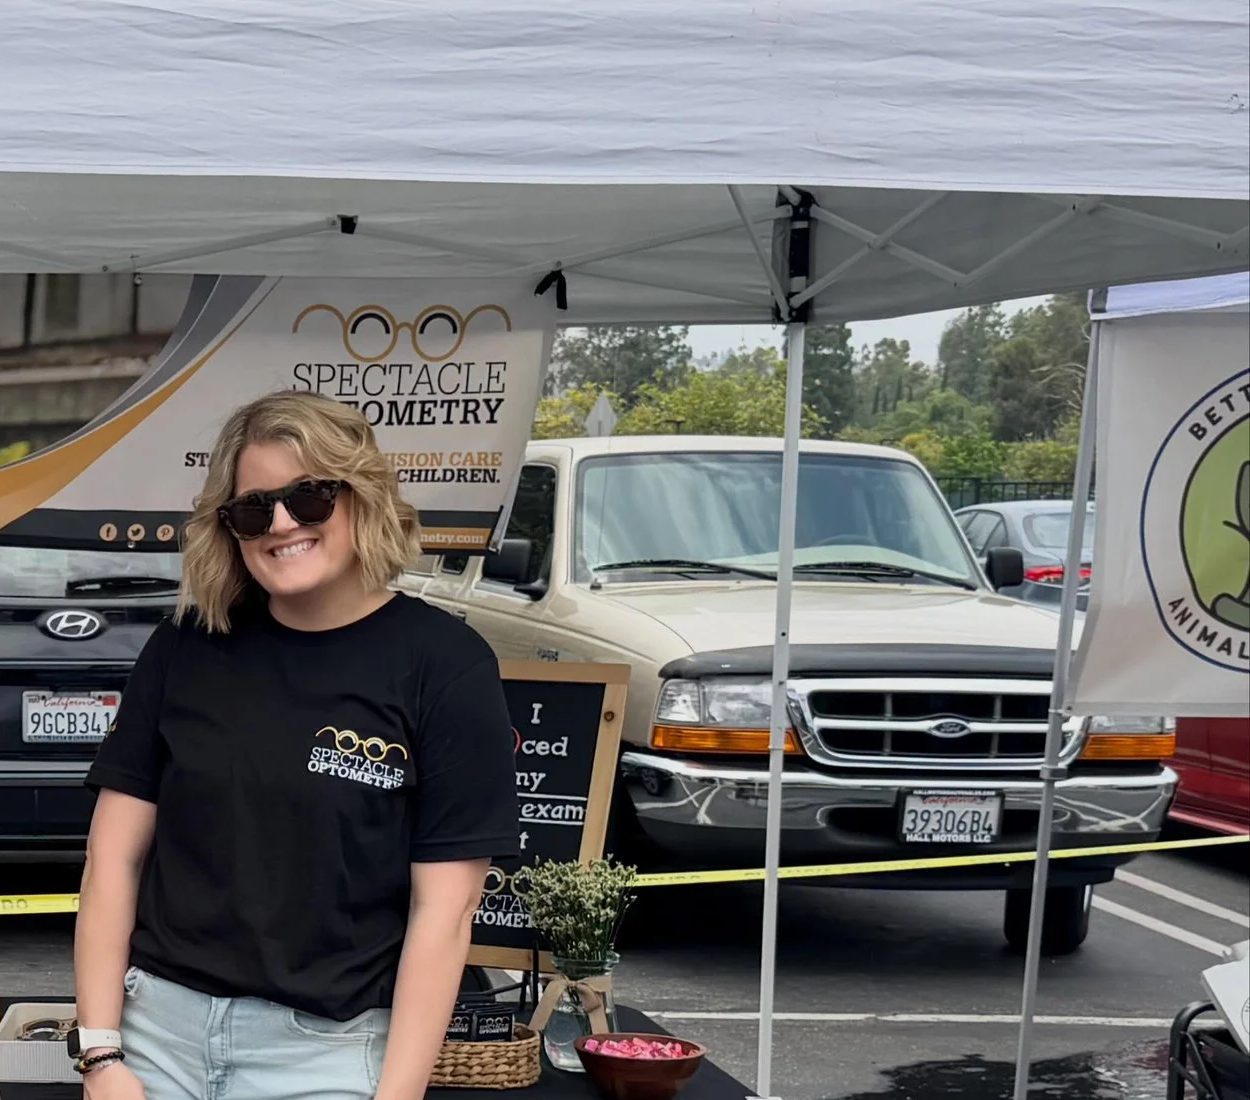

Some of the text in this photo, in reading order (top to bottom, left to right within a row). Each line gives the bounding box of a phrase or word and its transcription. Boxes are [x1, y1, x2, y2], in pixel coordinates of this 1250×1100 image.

[293, 362, 507, 396] SPECTACLE
[342, 397, 505, 427] OMETRY
[384, 452, 503, 468] ISION CARE
[397, 468, 501, 484] CHILDREN.
[1167, 597, 1249, 660] ANIMAL
[30, 711, 111, 735] 9GCB341
[531, 702, 543, 725] I
[521, 735, 569, 757] ced
[307, 760, 403, 790] OPTOMETRY
[310, 746, 405, 783] SPECTACLE
[521, 803, 584, 820] exam
[905, 808, 993, 834] 39306B4
[906, 833, 992, 843] HALL MOTORS LLC
